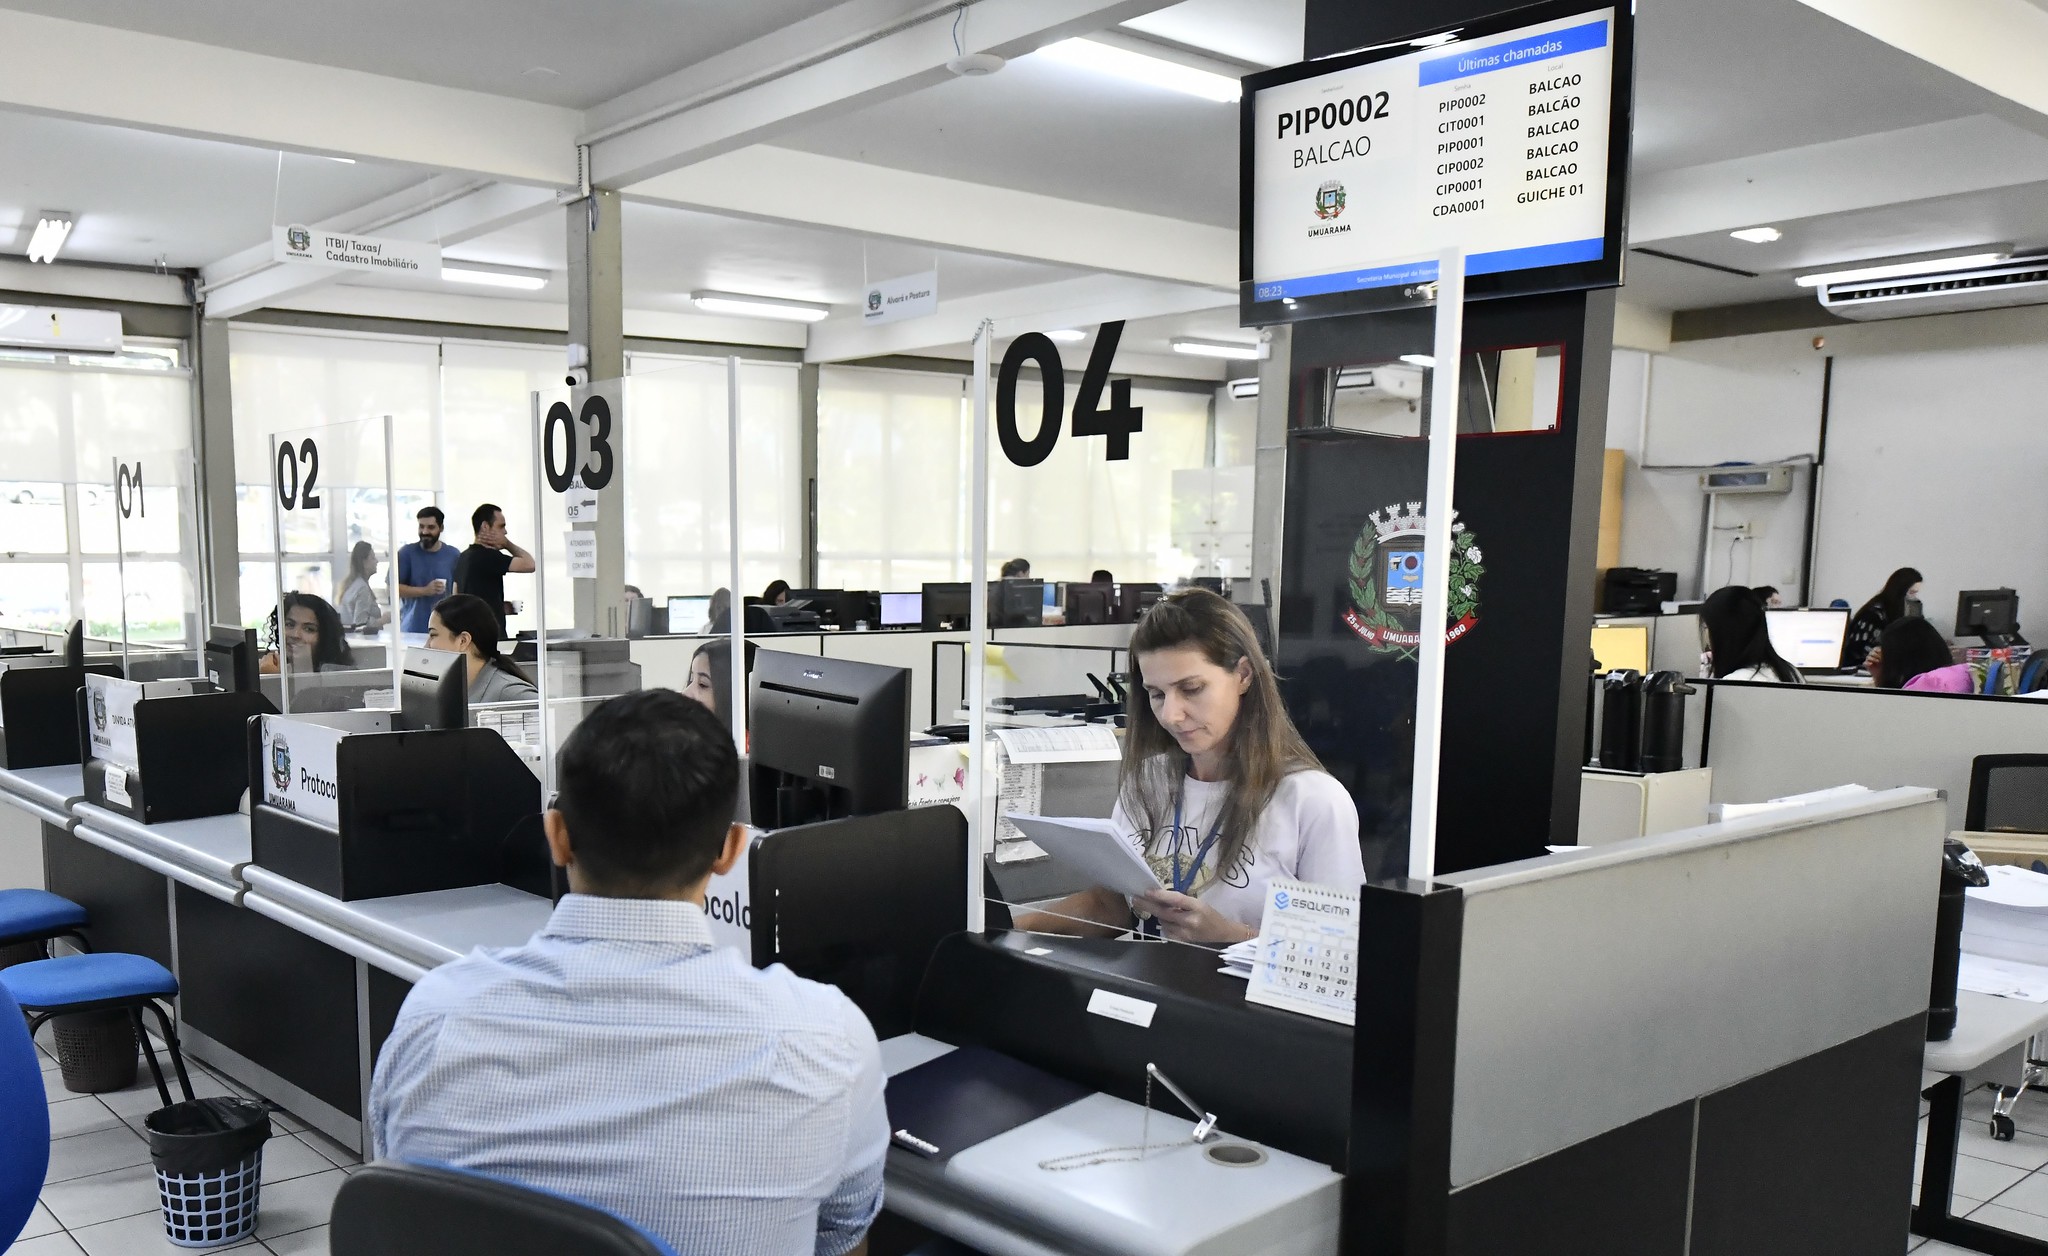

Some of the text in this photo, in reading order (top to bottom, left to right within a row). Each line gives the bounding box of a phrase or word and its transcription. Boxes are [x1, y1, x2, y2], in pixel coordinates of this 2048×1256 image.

[1458, 40, 1562, 72] Últimas chamadas
[1529, 74, 1581, 95] BALCAO
[1439, 94, 1486, 113] PIP0002
[1528, 95, 1581, 116] BALCÃO
[1278, 91, 1389, 139] PIP0002
[1438, 115, 1484, 133] CIT0001
[1527, 118, 1580, 138] BALCAO
[1294, 136, 1371, 168] BALCAO
[1438, 136, 1484, 154] PIP0001
[1526, 140, 1579, 160] BALCAO
[1437, 157, 1484, 175] CIP0002
[1526, 163, 1578, 181] BALCAO
[1436, 178, 1482, 195] CIP0001
[1517, 183, 1584, 204] GUICHE 01
[1432, 199, 1485, 217] CDA0001
[1308, 224, 1351, 238] UMUARAMA
[325, 237, 382, 255] ITBI/ Taxas/
[326, 251, 419, 270] Cadastro Imobiliário
[1418, 266, 1439, 276] Fazend
[1258, 285, 1283, 298] 08:23
[996, 320, 1143, 467] 04
[544, 395, 613, 493] 03
[278, 437, 320, 511] 02
[118, 461, 145, 519] 01
[570, 480, 587, 489] BAL
[567, 505, 579, 516] 05
[1346, 613, 1357, 625] 25
[1358, 625, 1375, 640] JULHO
[1445, 623, 1466, 642] 1960
[1382, 630, 1420, 644] UMUARA
[301, 767, 337, 800] Protoco
[1291, 898, 1350, 917] ESQUEMA
[1290, 942, 1296, 950] 3
[1343, 953, 1349, 961] 6
[1286, 954, 1296, 962] 10
[1304, 958, 1313, 966] 11
[1321, 961, 1331, 970] 12
[1339, 965, 1349, 974] 13
[1302, 970, 1311, 978] 18
[1319, 974, 1330, 982] 19
[1298, 981, 1308, 990] 25
[1315, 985, 1326, 994] 26
[1333, 989, 1345, 998] 27
